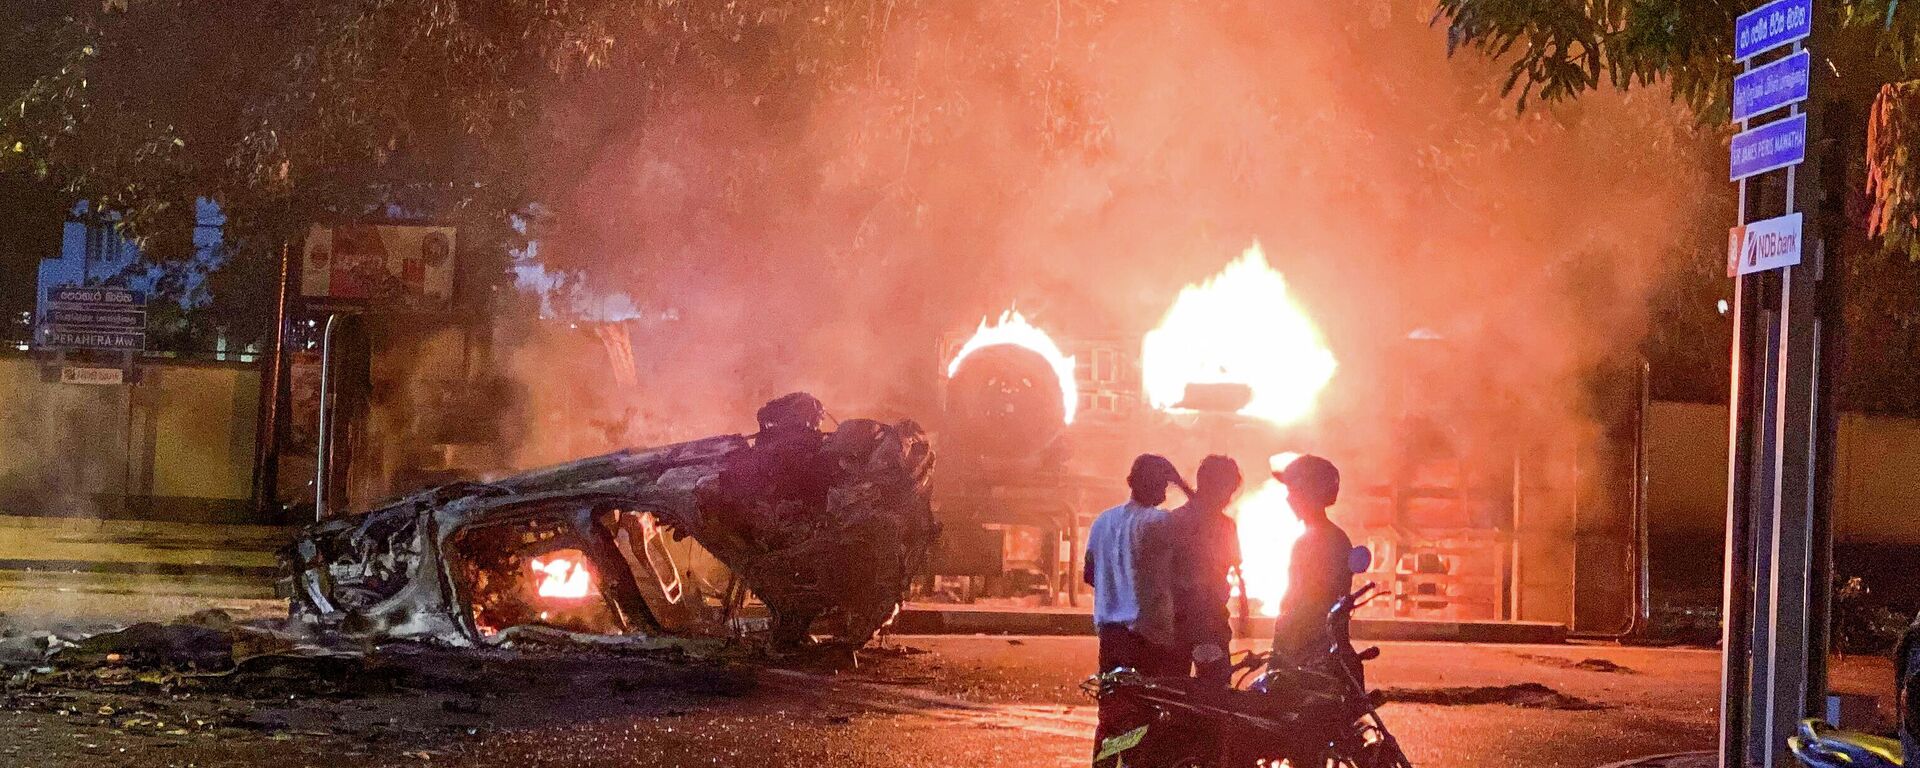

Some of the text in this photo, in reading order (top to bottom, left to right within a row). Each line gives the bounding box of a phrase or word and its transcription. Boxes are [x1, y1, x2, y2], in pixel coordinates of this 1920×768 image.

[1741, 143, 1758, 163] JAMES
[1774, 129, 1803, 153] MAWATHA
[1759, 227, 1797, 258] NDB bank
[53, 333, 111, 346] PERAHERA
